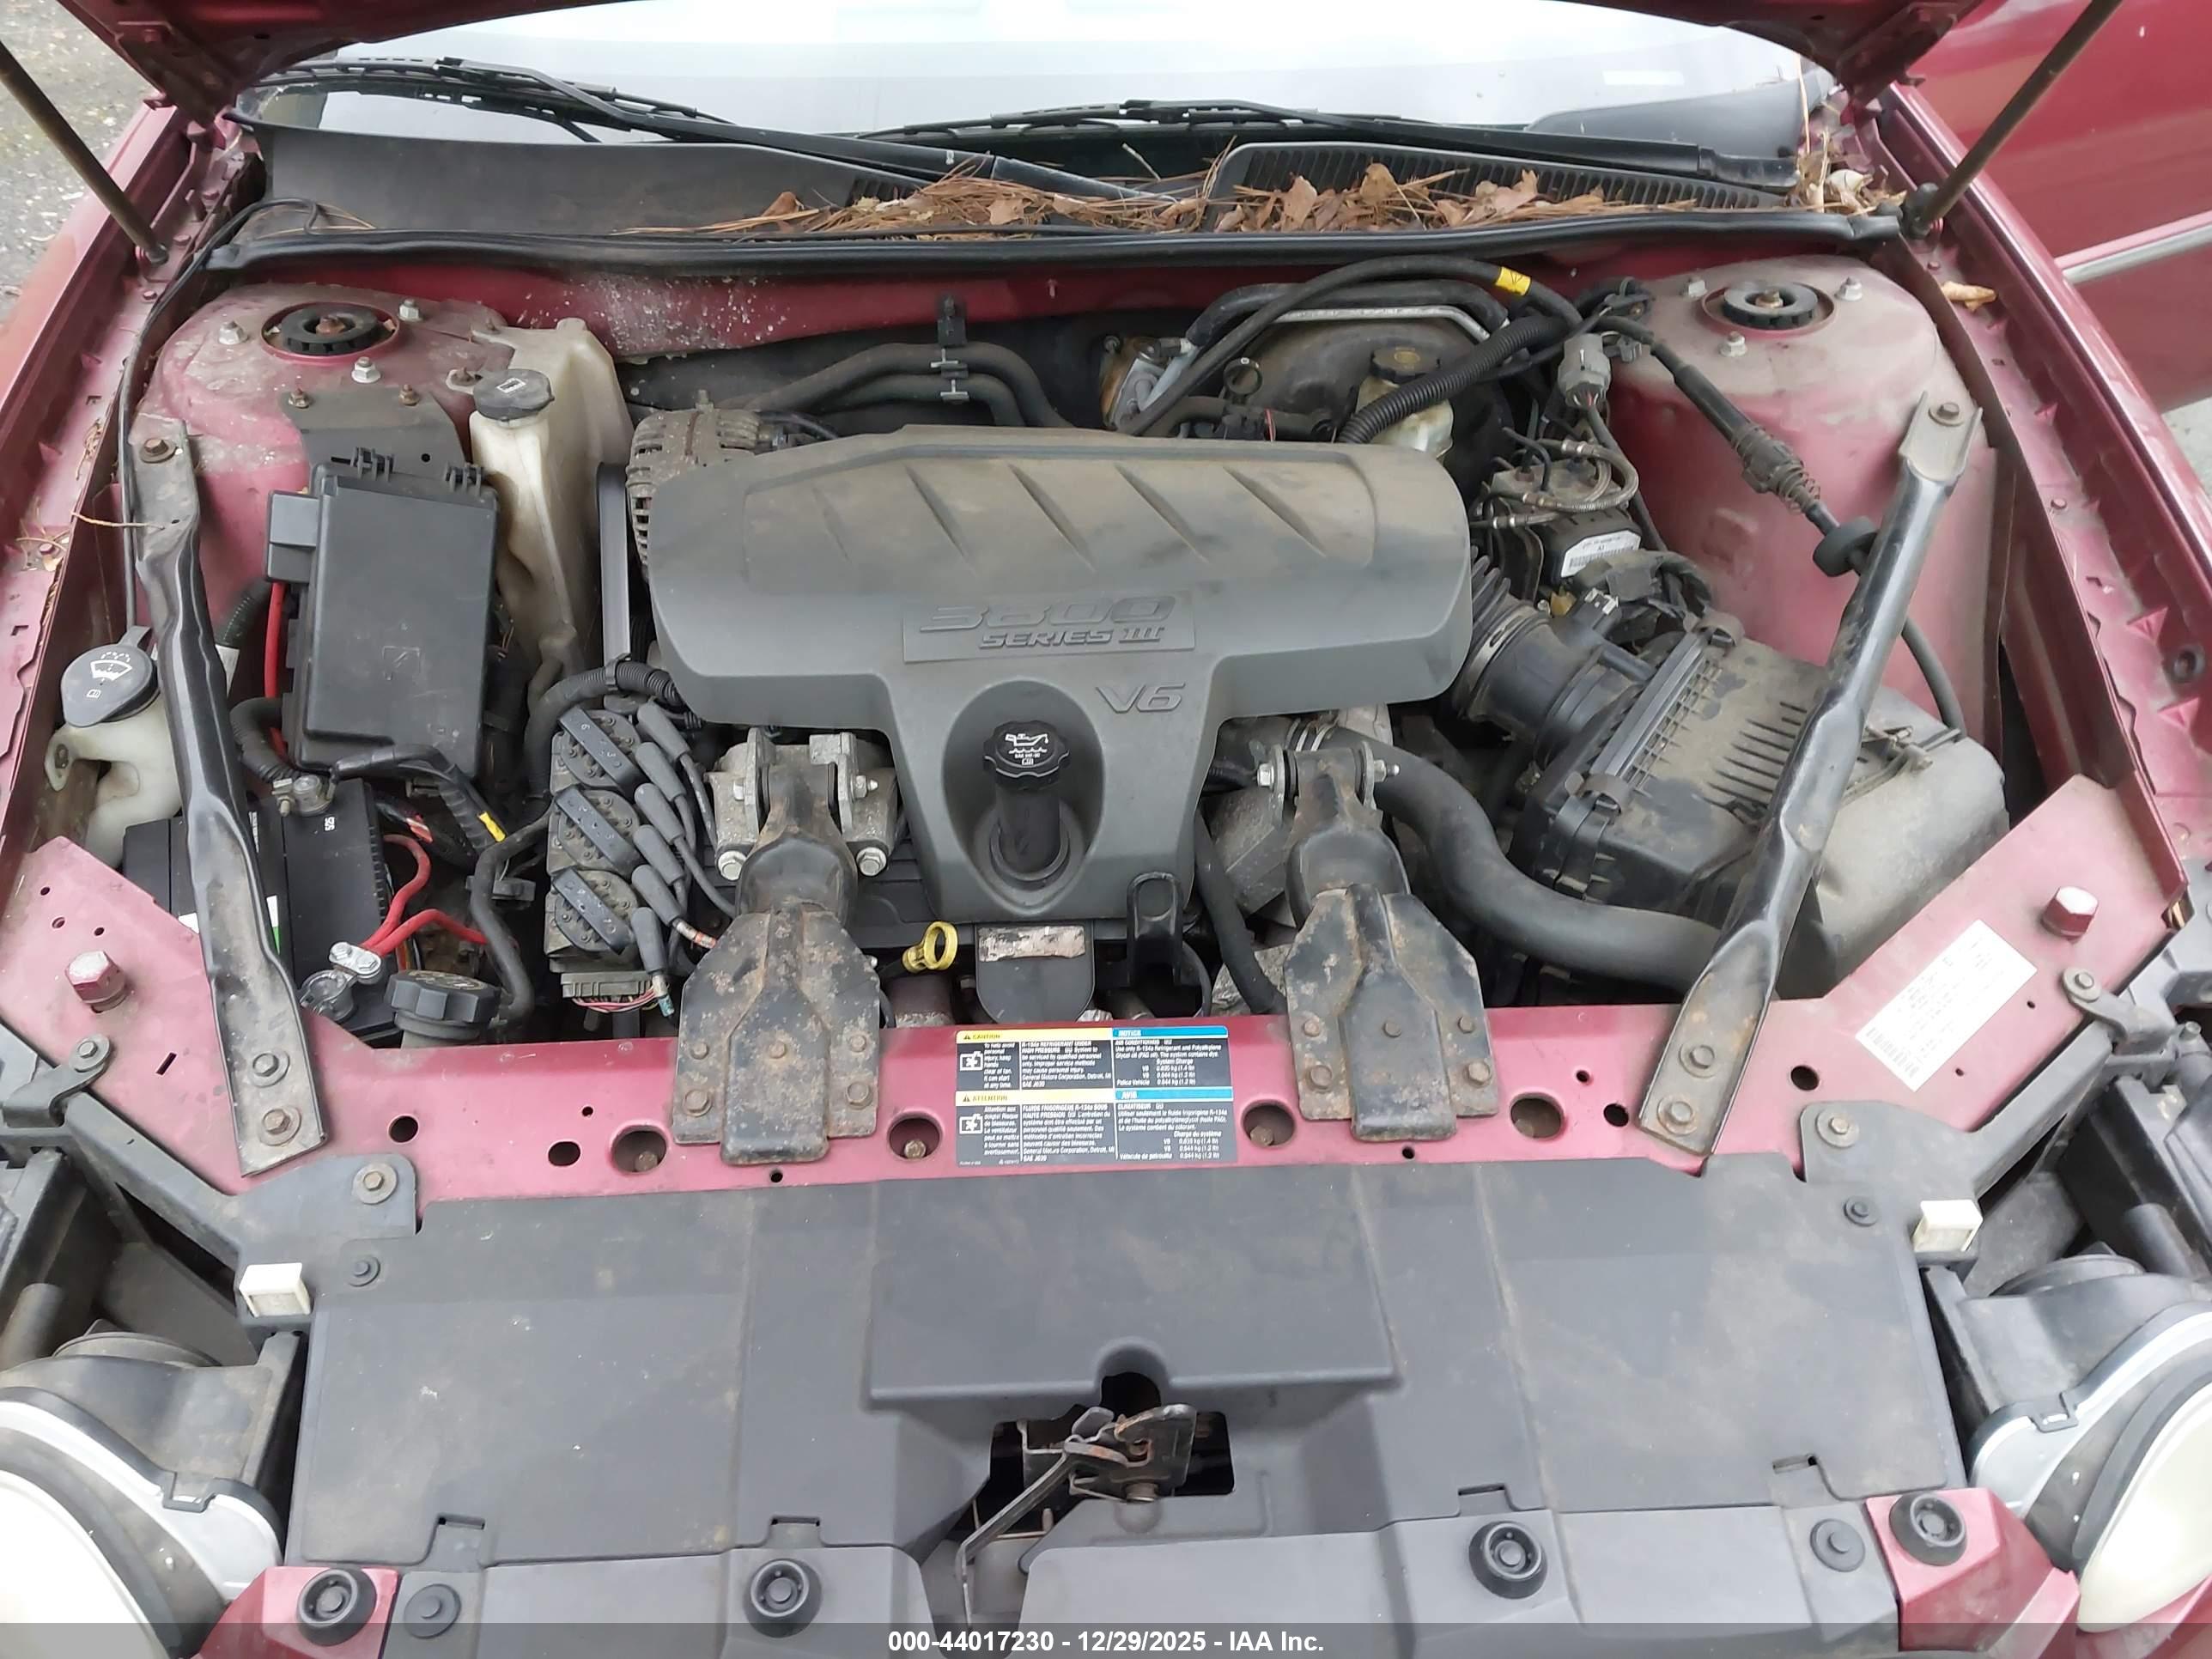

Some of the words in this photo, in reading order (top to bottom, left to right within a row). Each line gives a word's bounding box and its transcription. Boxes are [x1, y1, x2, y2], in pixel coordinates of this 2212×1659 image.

[920, 595, 1176, 633] 3800
[979, 629, 1115, 650] SERIES
[1118, 627, 1165, 644] III
[1095, 683, 1187, 714] V6
